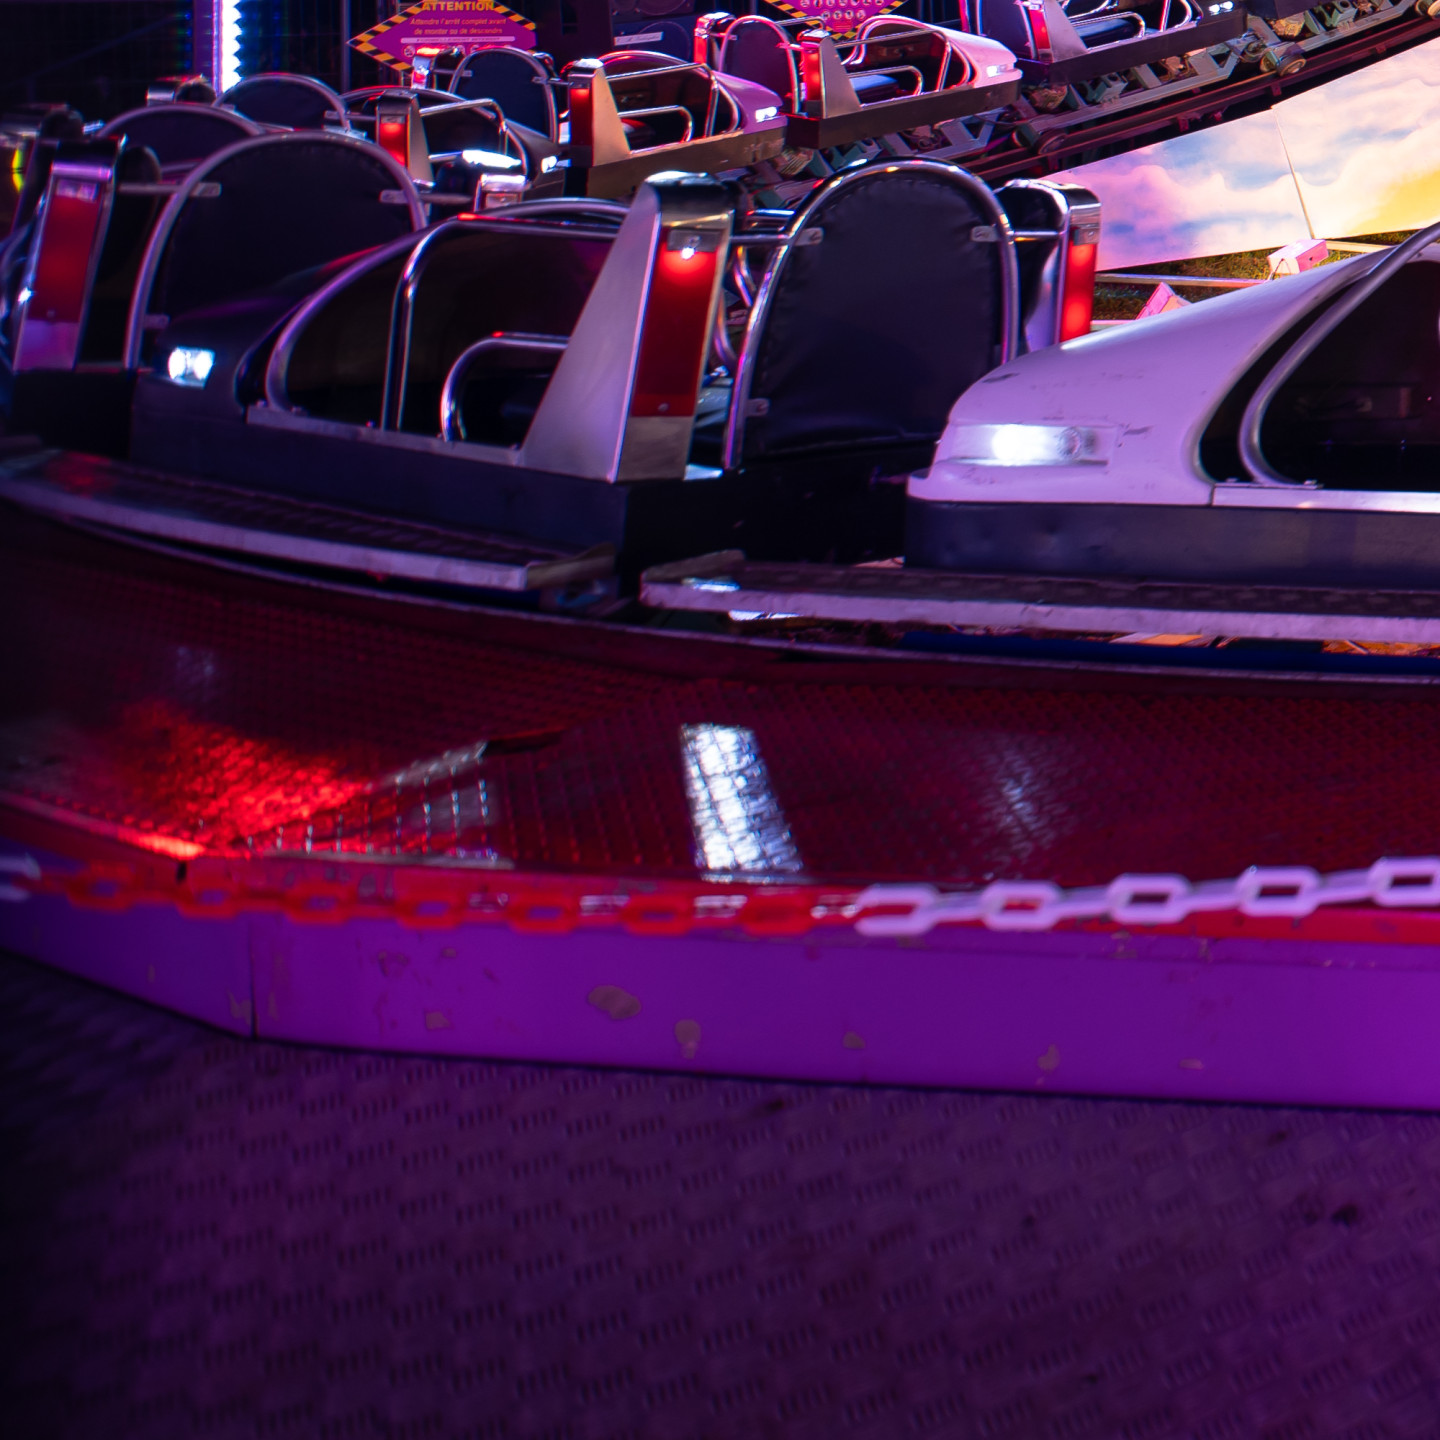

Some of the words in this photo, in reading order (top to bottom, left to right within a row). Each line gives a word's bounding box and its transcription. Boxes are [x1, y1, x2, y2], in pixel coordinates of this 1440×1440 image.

[422, 1, 495, 11] ATTENTION
[462, 17, 488, 25] complet
[469, 27, 503, 35] descendre
